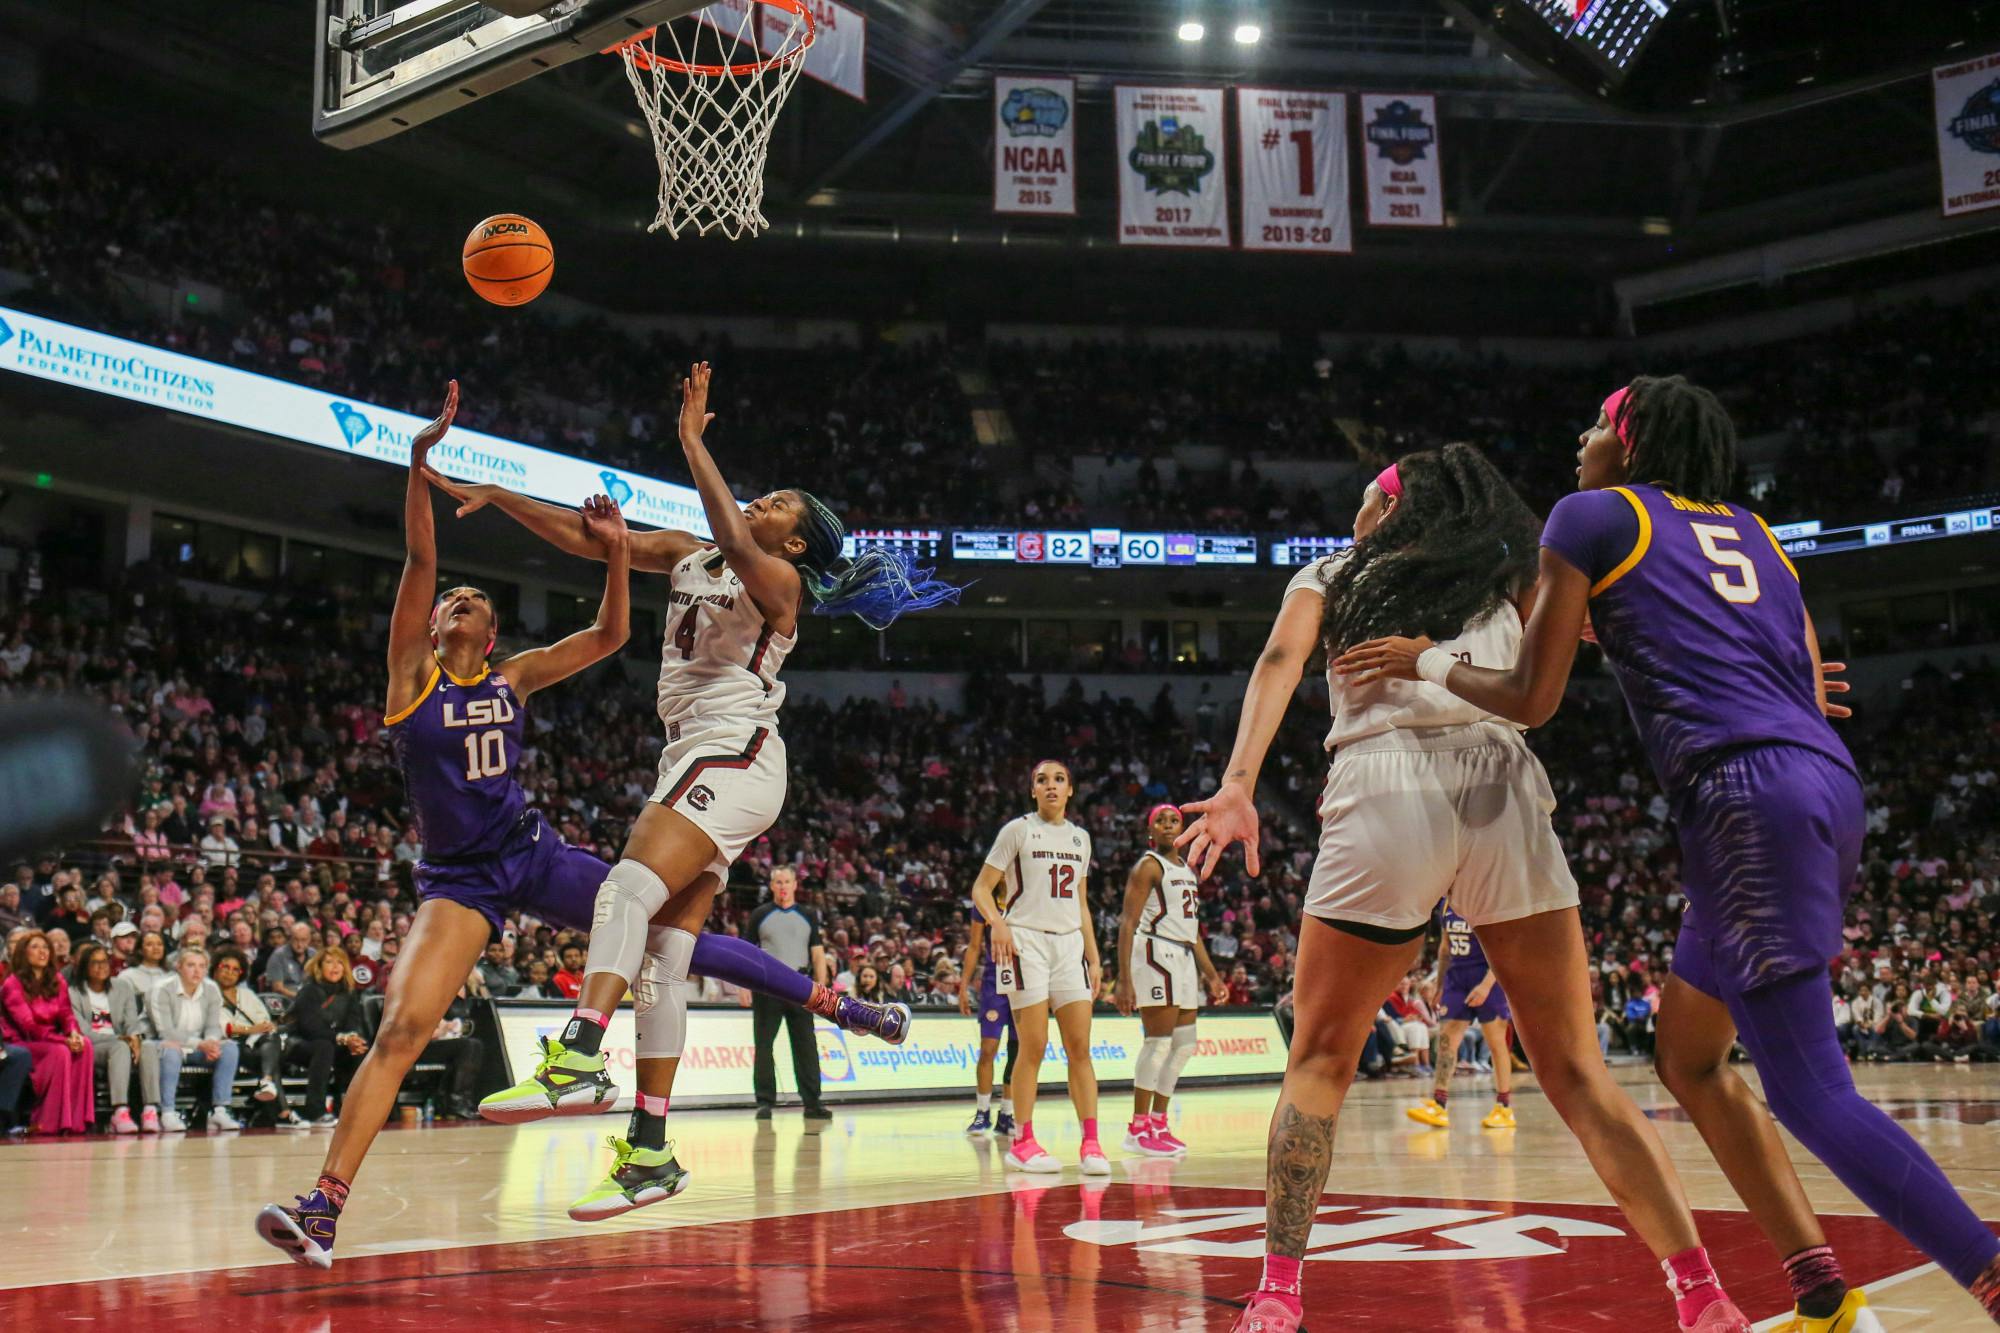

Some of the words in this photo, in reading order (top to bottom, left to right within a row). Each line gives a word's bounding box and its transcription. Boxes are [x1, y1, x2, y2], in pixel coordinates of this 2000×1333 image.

[1955, 113, 1997, 133] FINAL
[1003, 146, 1067, 173] NCAA
[1017, 189, 1053, 206] 2015
[1156, 206, 1192, 223] 2017
[483, 223, 529, 239] NCAA
[1262, 225, 1333, 244] 2019-20
[17, 353, 93, 382] FEDERAL
[99, 373, 160, 399] CREDIT
[166, 391, 215, 411] UNION
[1871, 530, 1886, 541] 40
[1900, 523, 1937, 538] FINAL
[1052, 538, 1084, 558] 82
[1127, 539, 1160, 559] 60
[1689, 521, 1761, 604] 5
[674, 604, 700, 661] 4
[443, 698, 515, 728] LSU
[464, 728, 508, 782] 10
[1032, 851, 1054, 860] SOUTH
[1048, 863, 1075, 899] 12
[1445, 920, 1473, 934] LSU
[1448, 934, 1471, 957] 55
[1218, 1038, 1270, 1055] MARKET
[857, 1042, 968, 1073] suspiciously
